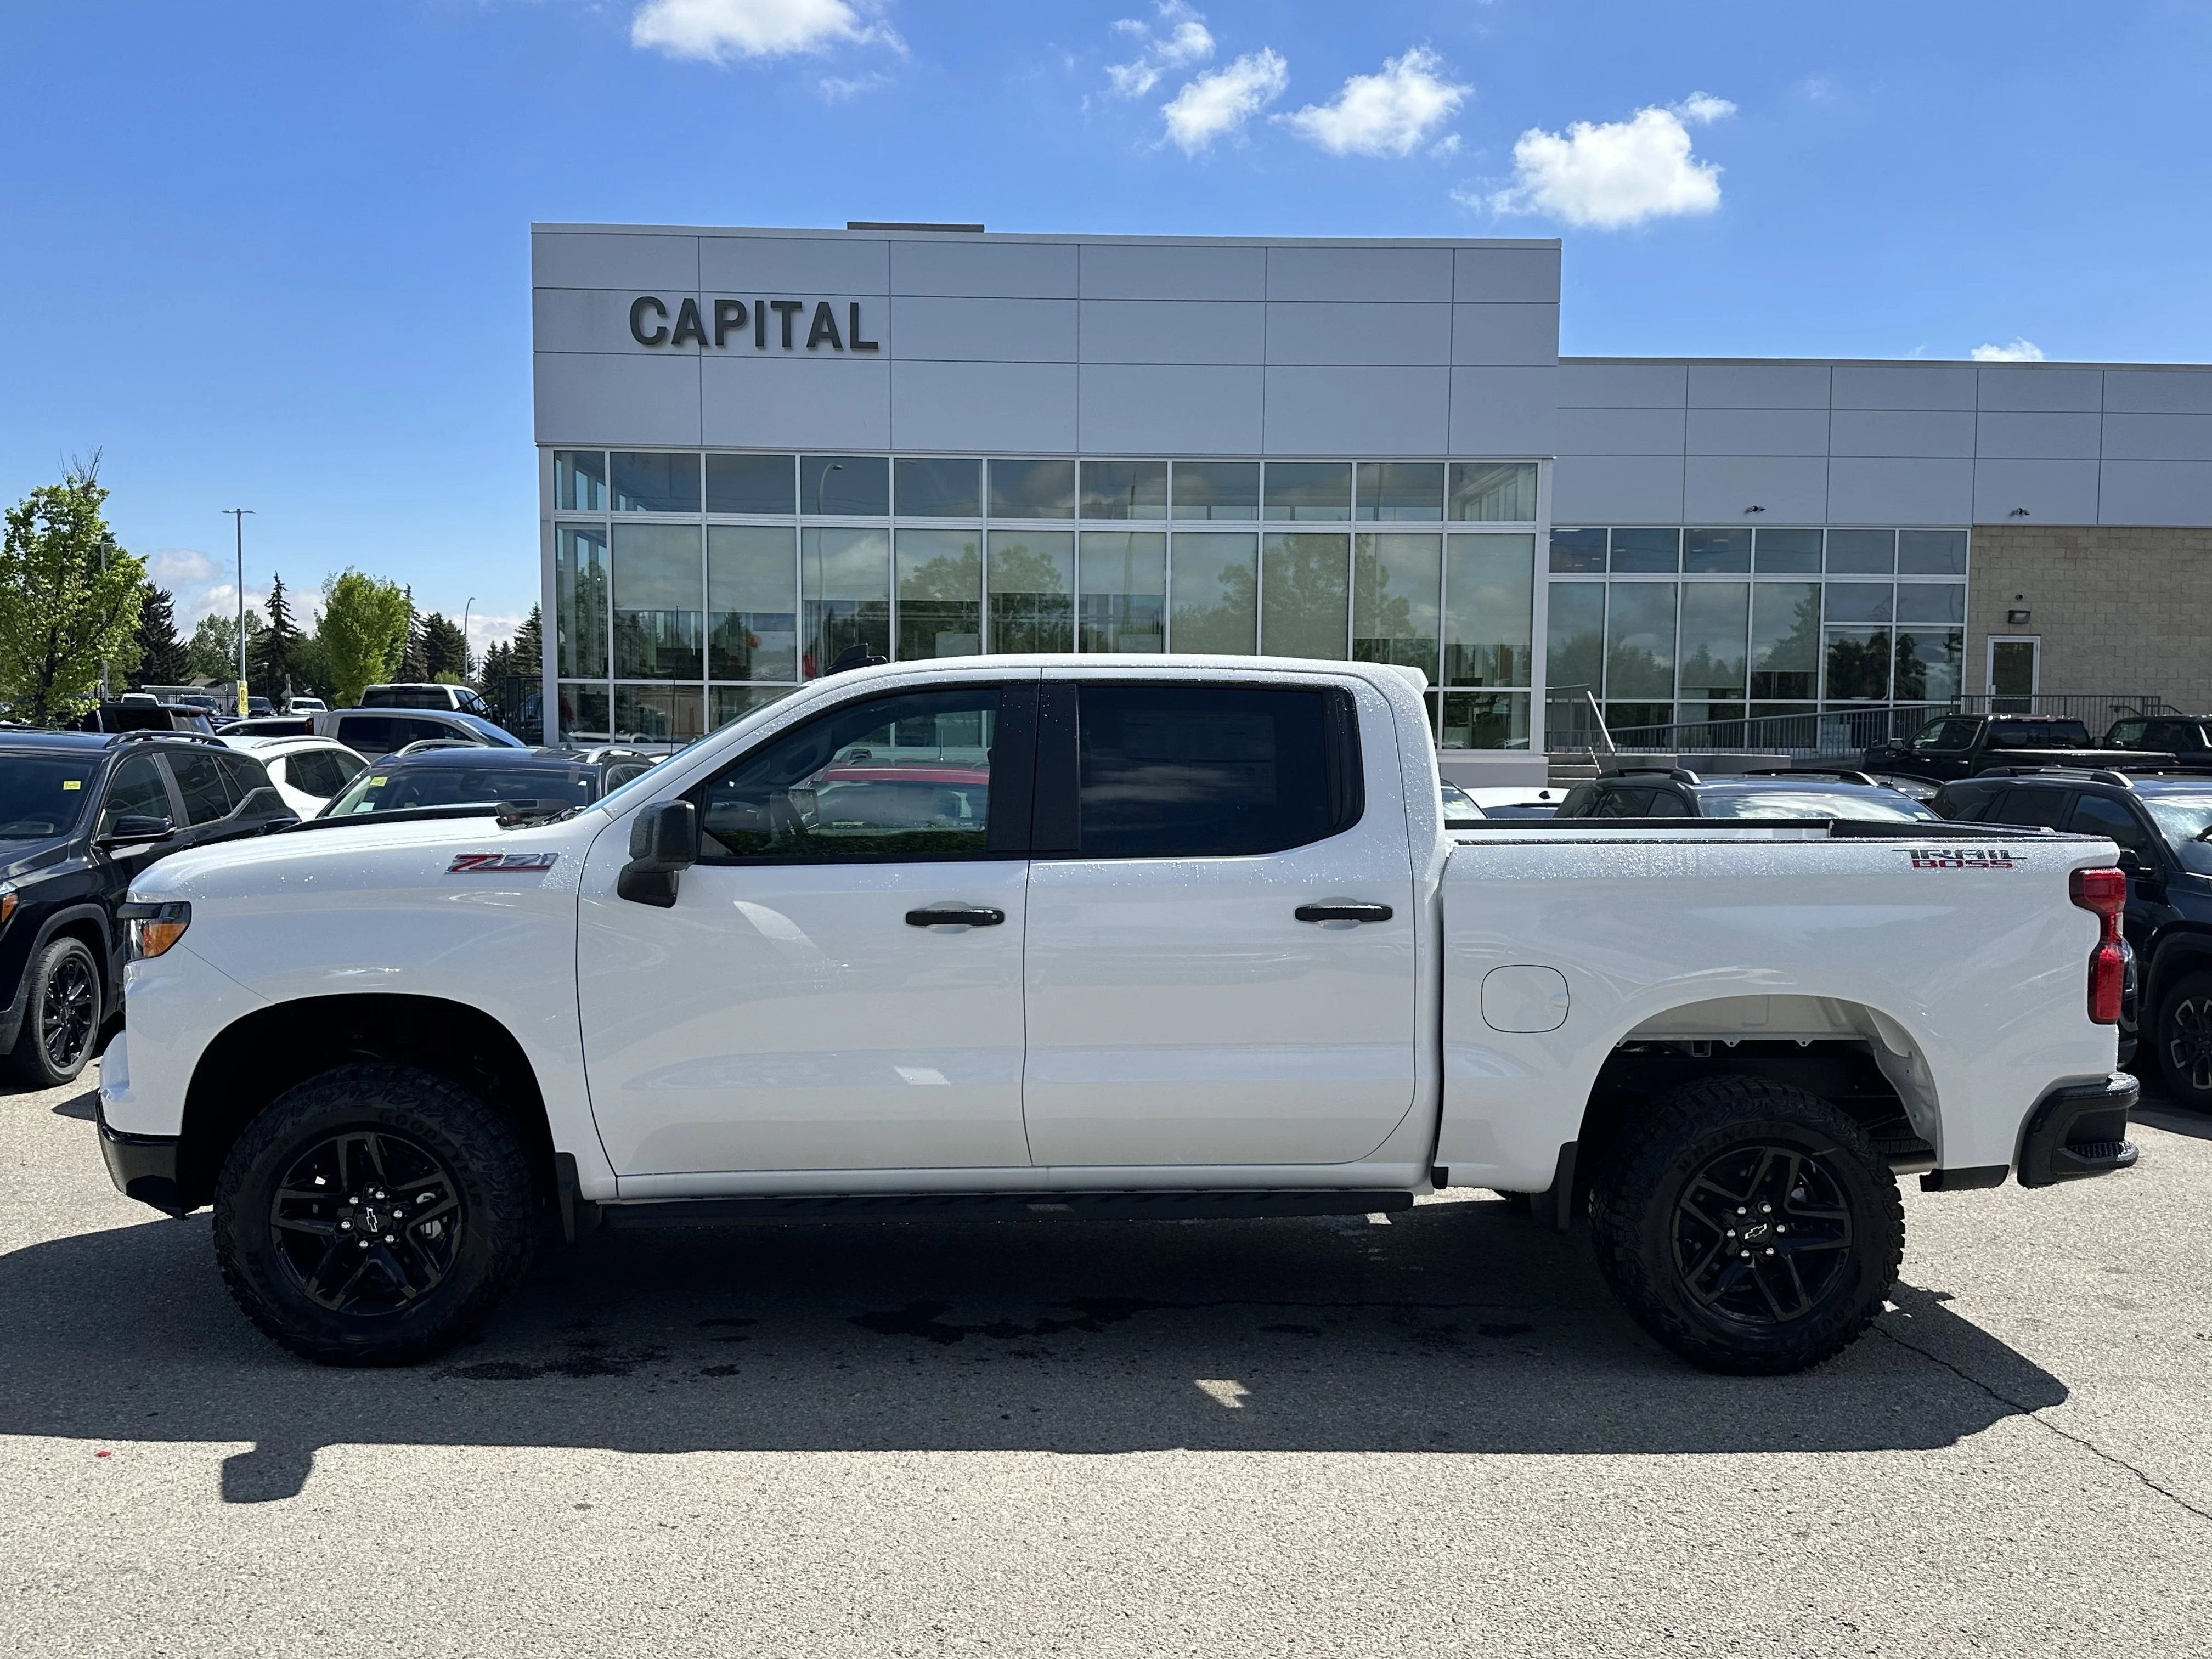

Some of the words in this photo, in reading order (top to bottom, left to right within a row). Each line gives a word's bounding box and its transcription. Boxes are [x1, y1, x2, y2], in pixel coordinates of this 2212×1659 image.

[630, 296, 879, 350] CAPITAL
[1892, 849, 2028, 860] TRAIL
[445, 853, 561, 874] Z71
[1912, 860, 2013, 868] BOSS
